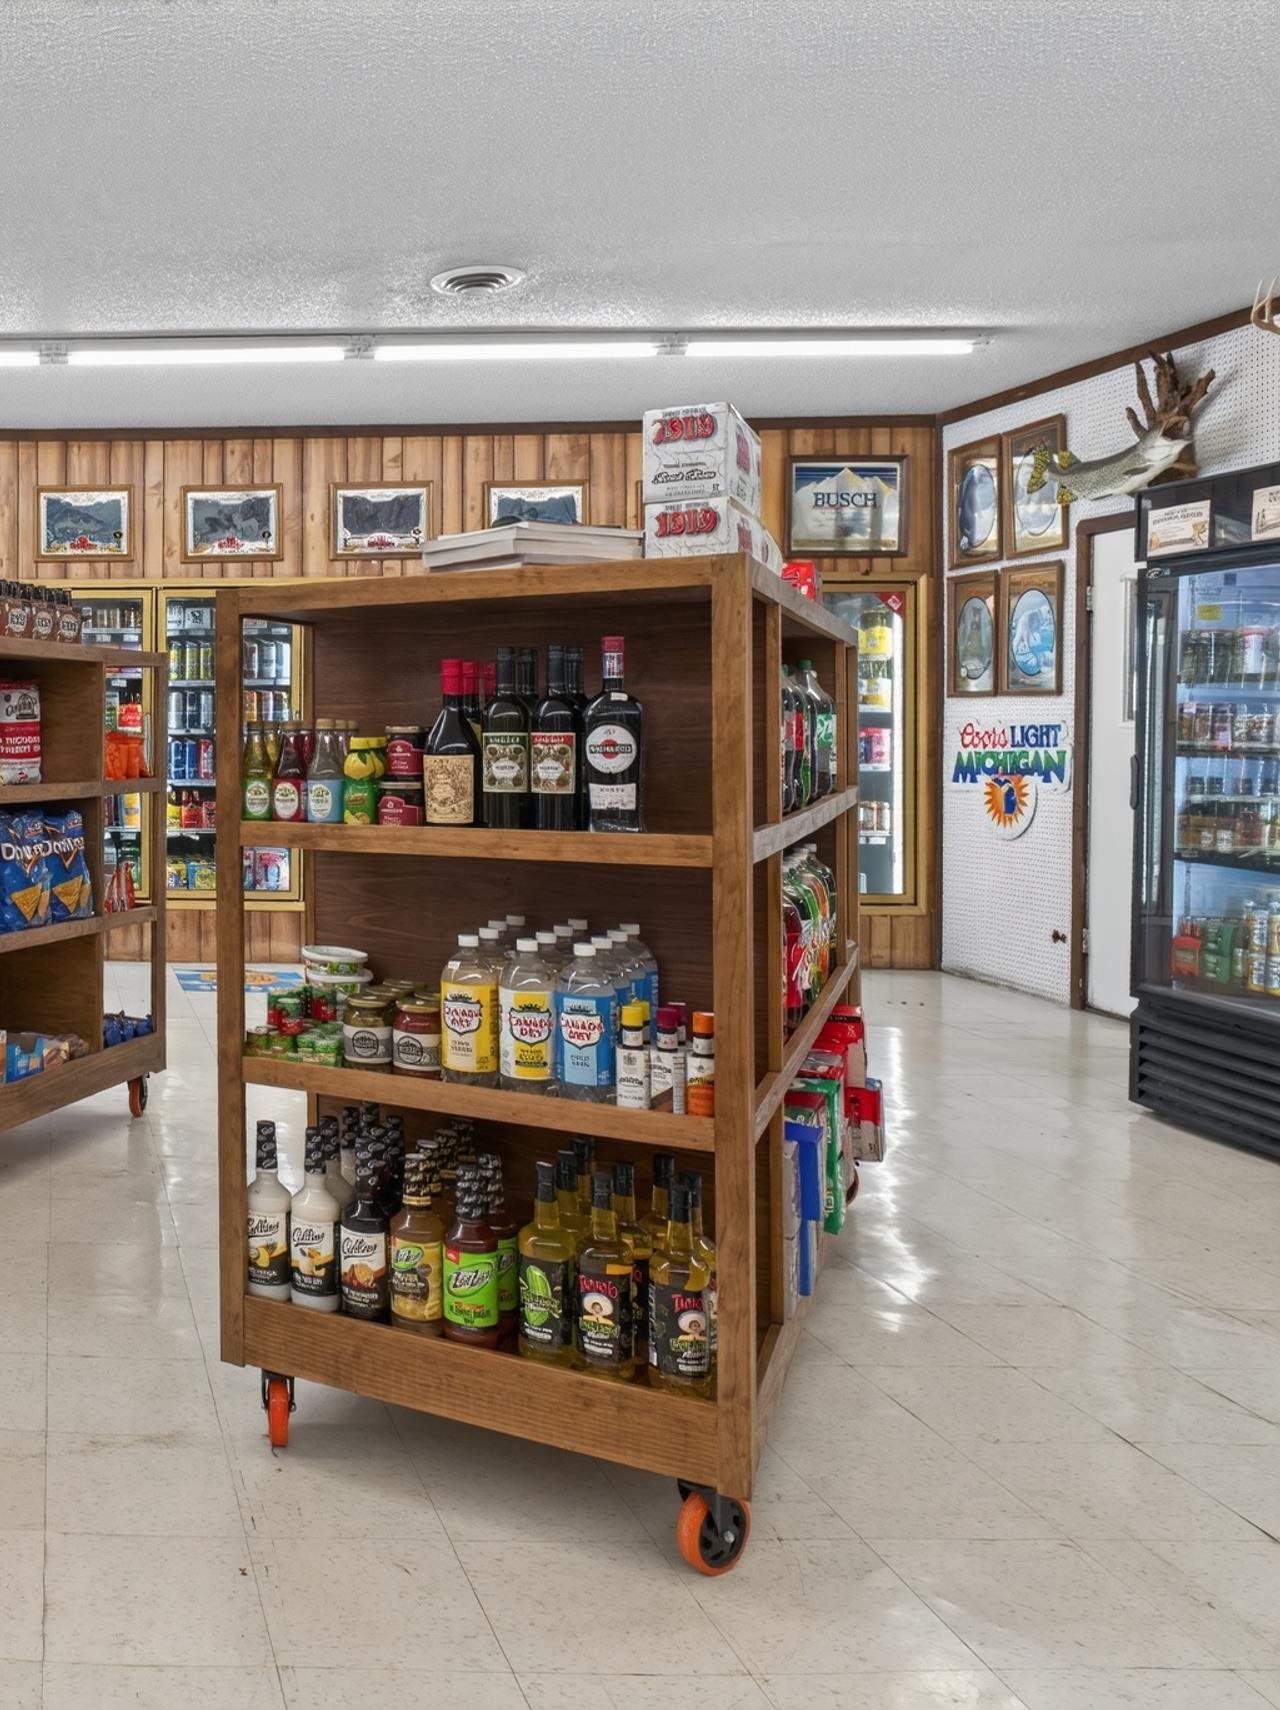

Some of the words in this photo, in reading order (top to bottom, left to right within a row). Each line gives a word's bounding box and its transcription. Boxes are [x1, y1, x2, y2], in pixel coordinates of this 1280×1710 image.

[652, 411, 716, 446] 1919
[813, 492, 878, 509] BUSCH
[655, 507, 719, 538] 1919
[961, 722, 1008, 749] Coors
[1010, 724, 1061, 748] LIGHT
[952, 750, 1067, 783] MICHIGAN
[445, 1006, 483, 1019] CANADA
[510, 1015, 554, 1030] CANADA
[561, 1016, 605, 1033] CANADA
[521, 1028, 542, 1039] DRY
